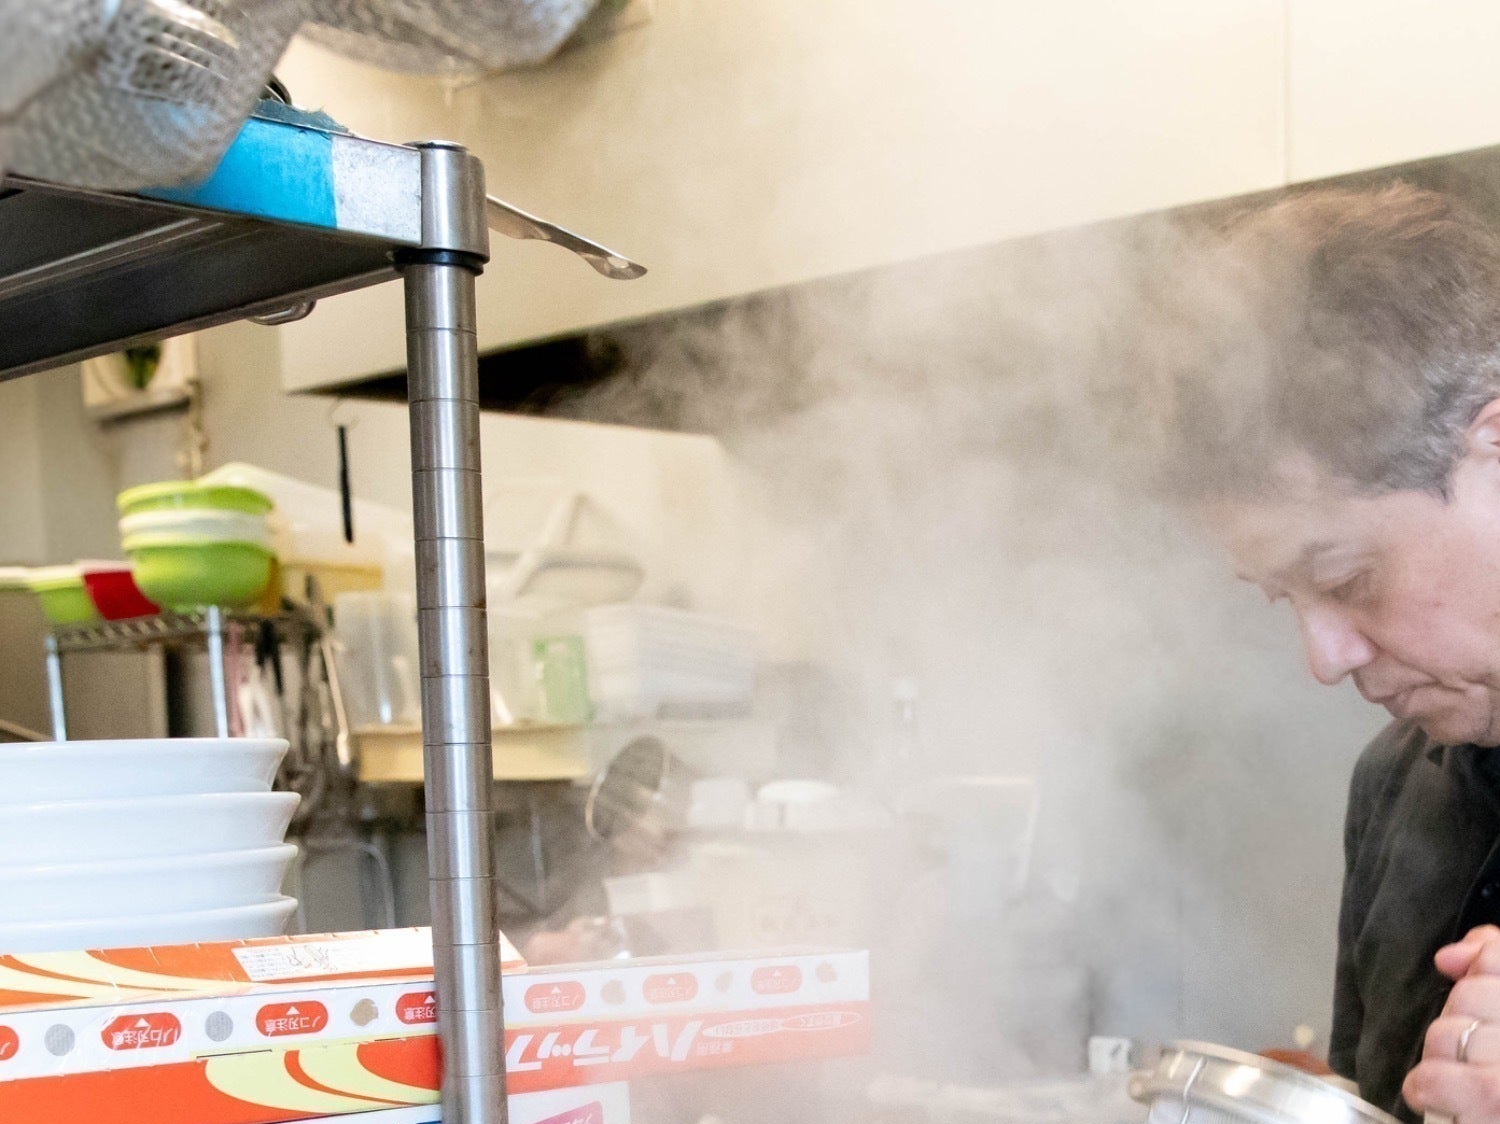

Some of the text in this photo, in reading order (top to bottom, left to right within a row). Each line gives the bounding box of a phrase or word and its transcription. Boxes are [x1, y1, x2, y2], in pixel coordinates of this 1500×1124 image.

[265, 1016, 321, 1033] ノコ刃注意
